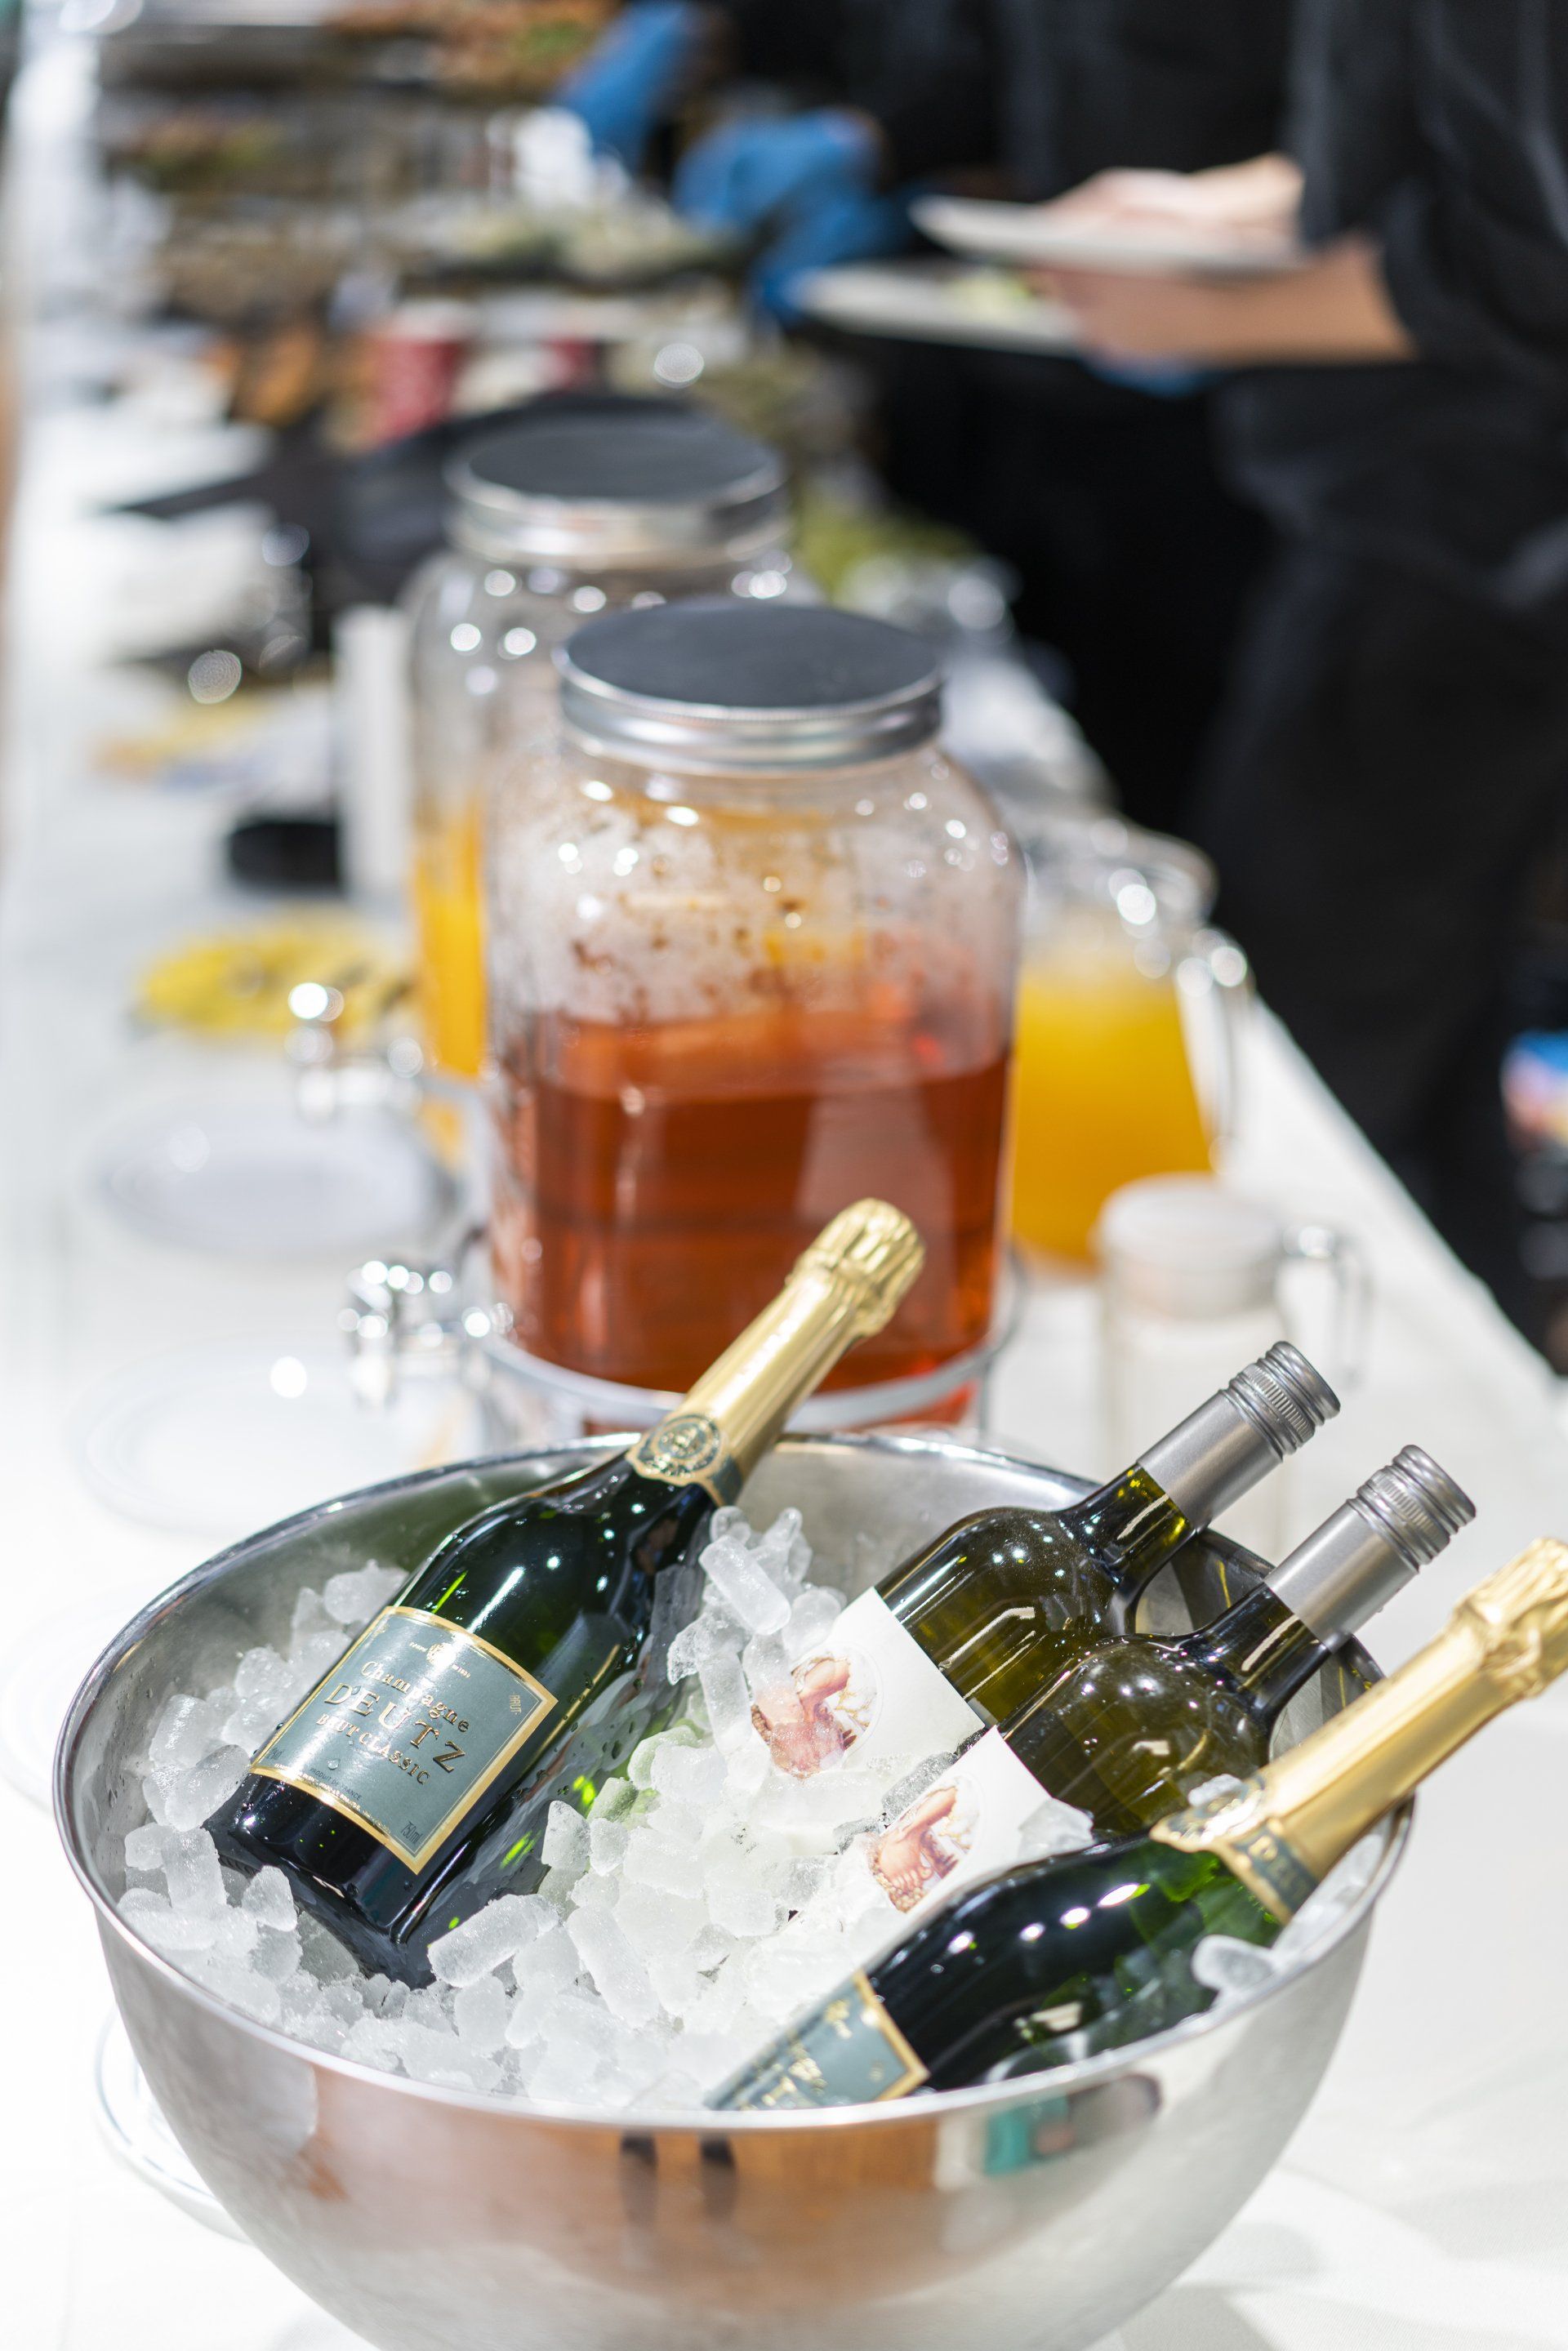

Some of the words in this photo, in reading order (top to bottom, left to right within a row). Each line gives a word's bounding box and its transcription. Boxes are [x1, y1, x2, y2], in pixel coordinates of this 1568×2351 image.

[361, 1661, 470, 1732] Champagne
[324, 1683, 466, 1773] DEUTZ
[359, 1732, 430, 1784] CLASSIC
[401, 1821, 423, 1844] 750ml
